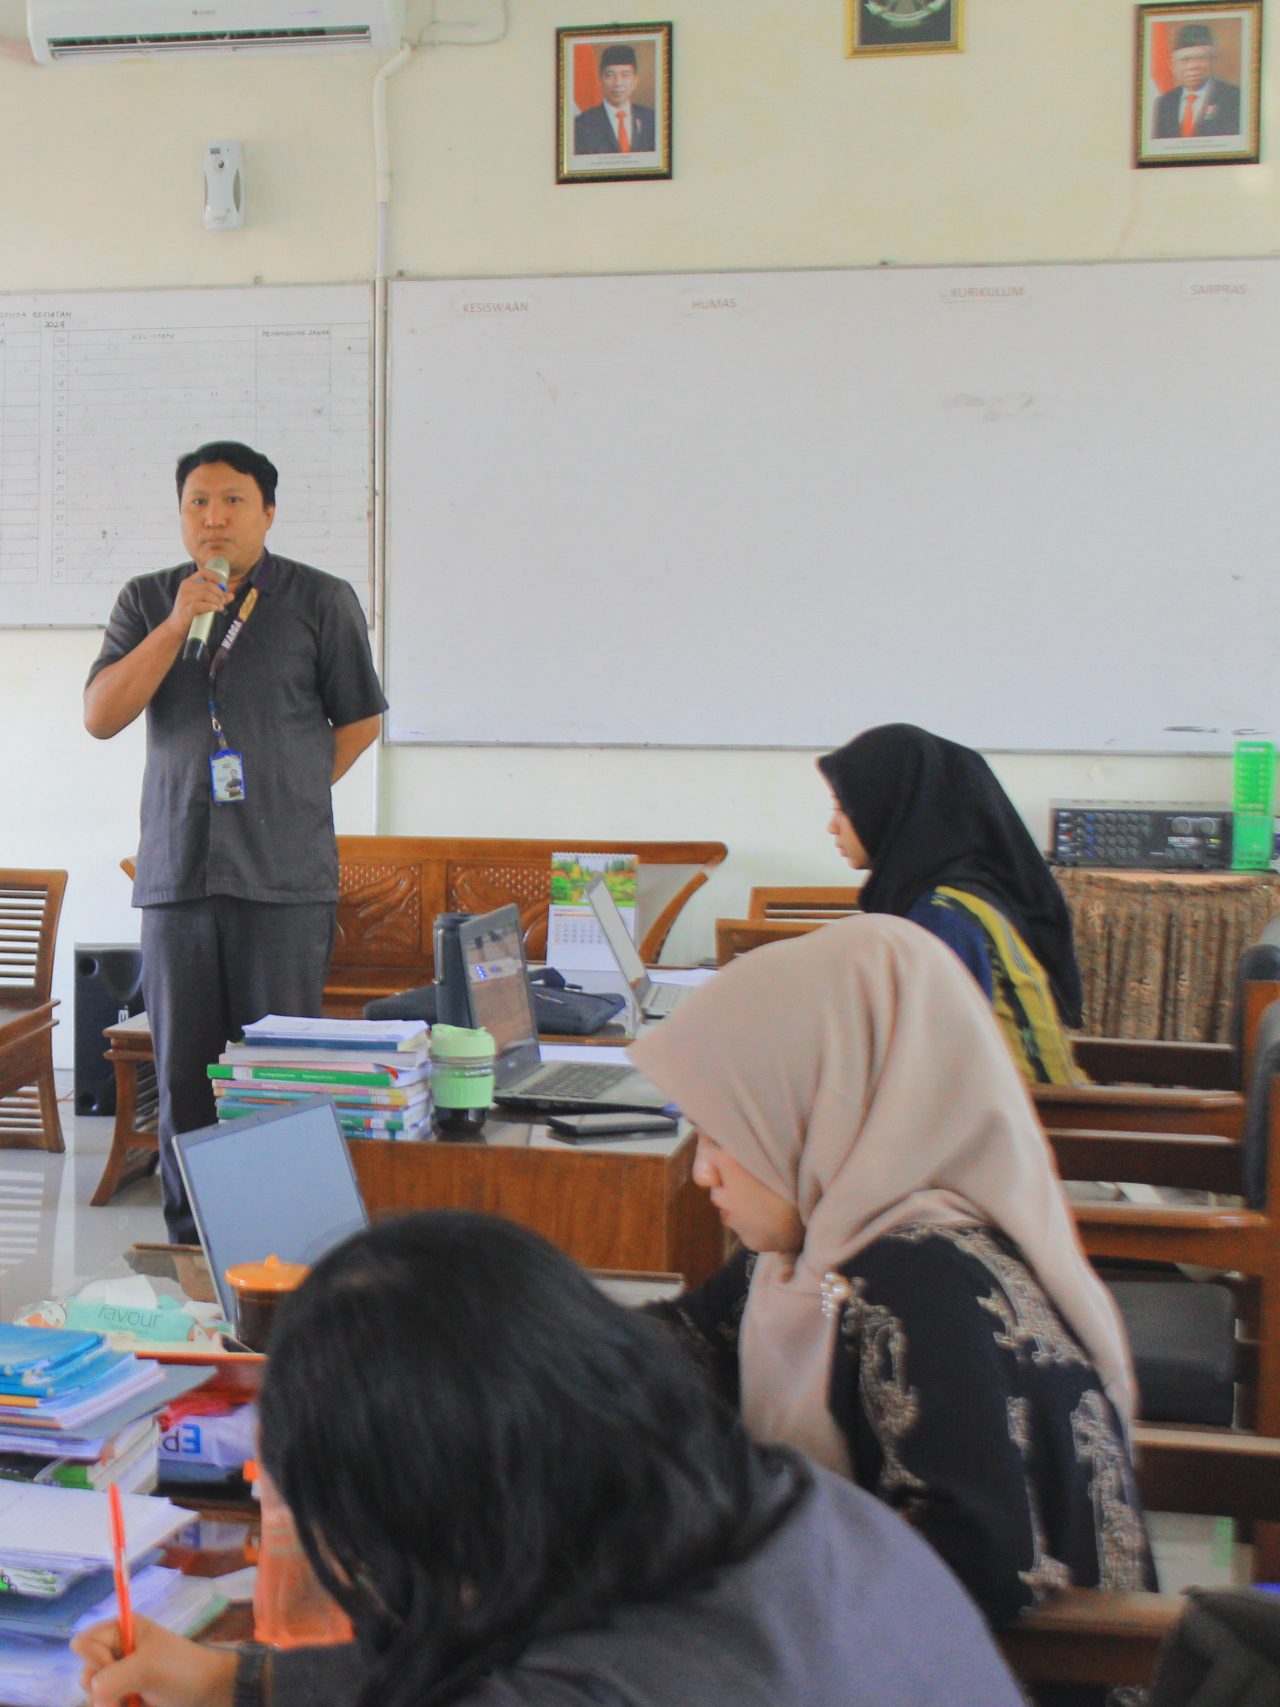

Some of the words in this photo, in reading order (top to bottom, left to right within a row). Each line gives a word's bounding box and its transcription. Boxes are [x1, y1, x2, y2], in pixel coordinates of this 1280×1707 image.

[951, 286, 1024, 297] KURIKULUM
[1190, 284, 1247, 295] SARPRAS
[462, 302, 529, 313] KESISWAAN
[692, 297, 737, 309] HUMAS
[221, 619, 243, 650] WARGA
[162, 1423, 201, 1455] EP
